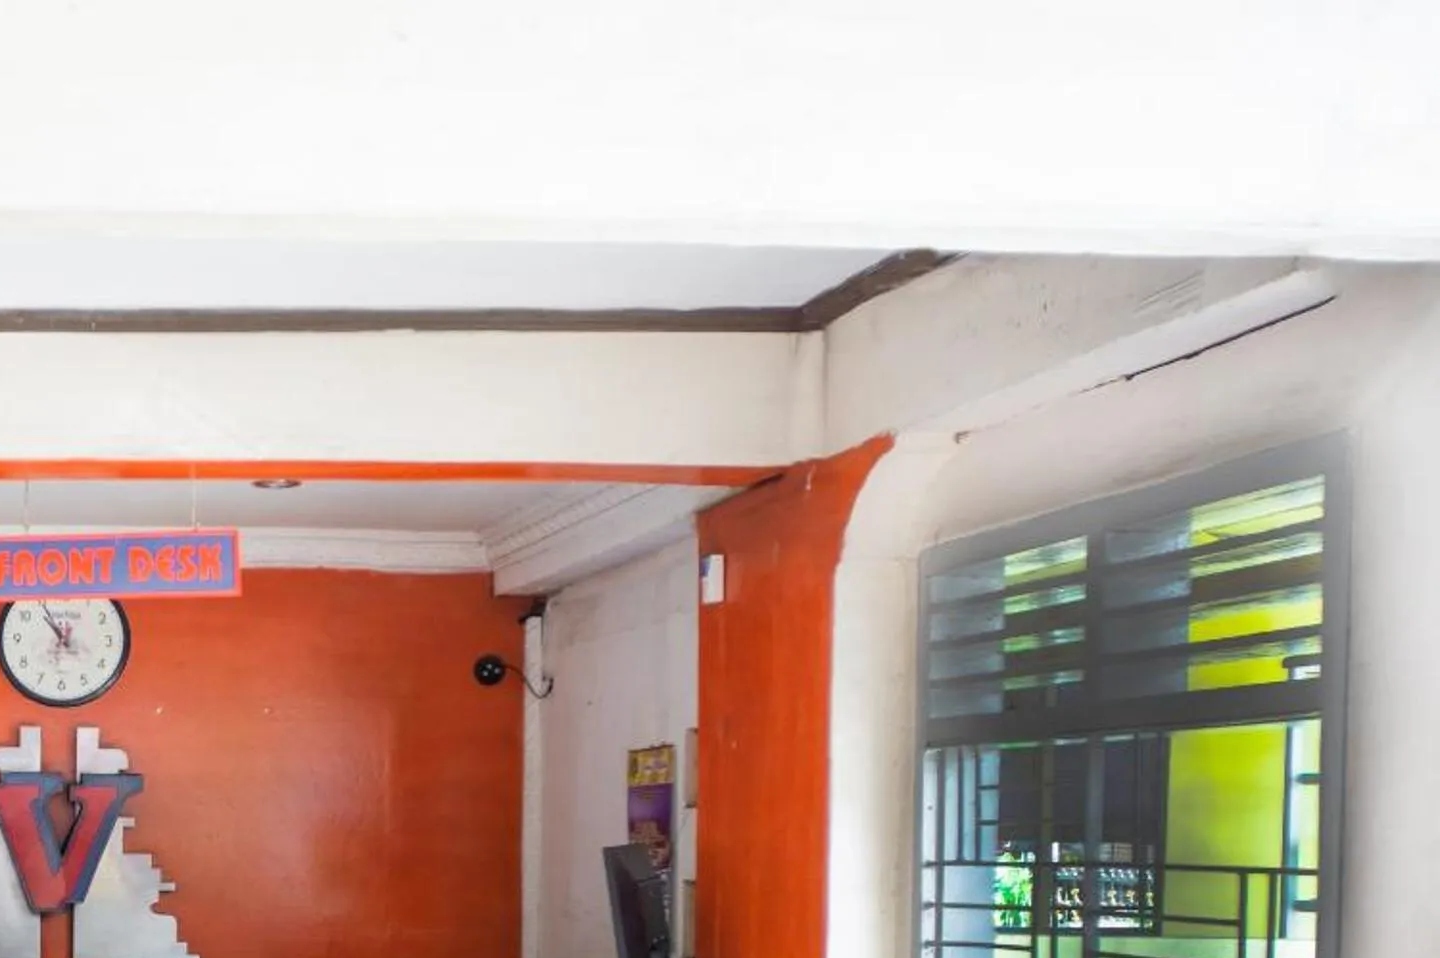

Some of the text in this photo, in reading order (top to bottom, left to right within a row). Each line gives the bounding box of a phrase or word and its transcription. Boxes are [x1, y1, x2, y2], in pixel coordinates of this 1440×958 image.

[128, 544, 222, 582] DESK
[19, 610, 32, 622] 10
[98, 612, 107, 625] 2
[13, 633, 22, 644] 9
[104, 634, 112, 647] 3
[19, 656, 28, 669] 8
[97, 658, 106, 669] 4
[37, 672, 46, 684] 7
[79, 674, 88, 687] 5
[57, 680, 66, 692] 6
